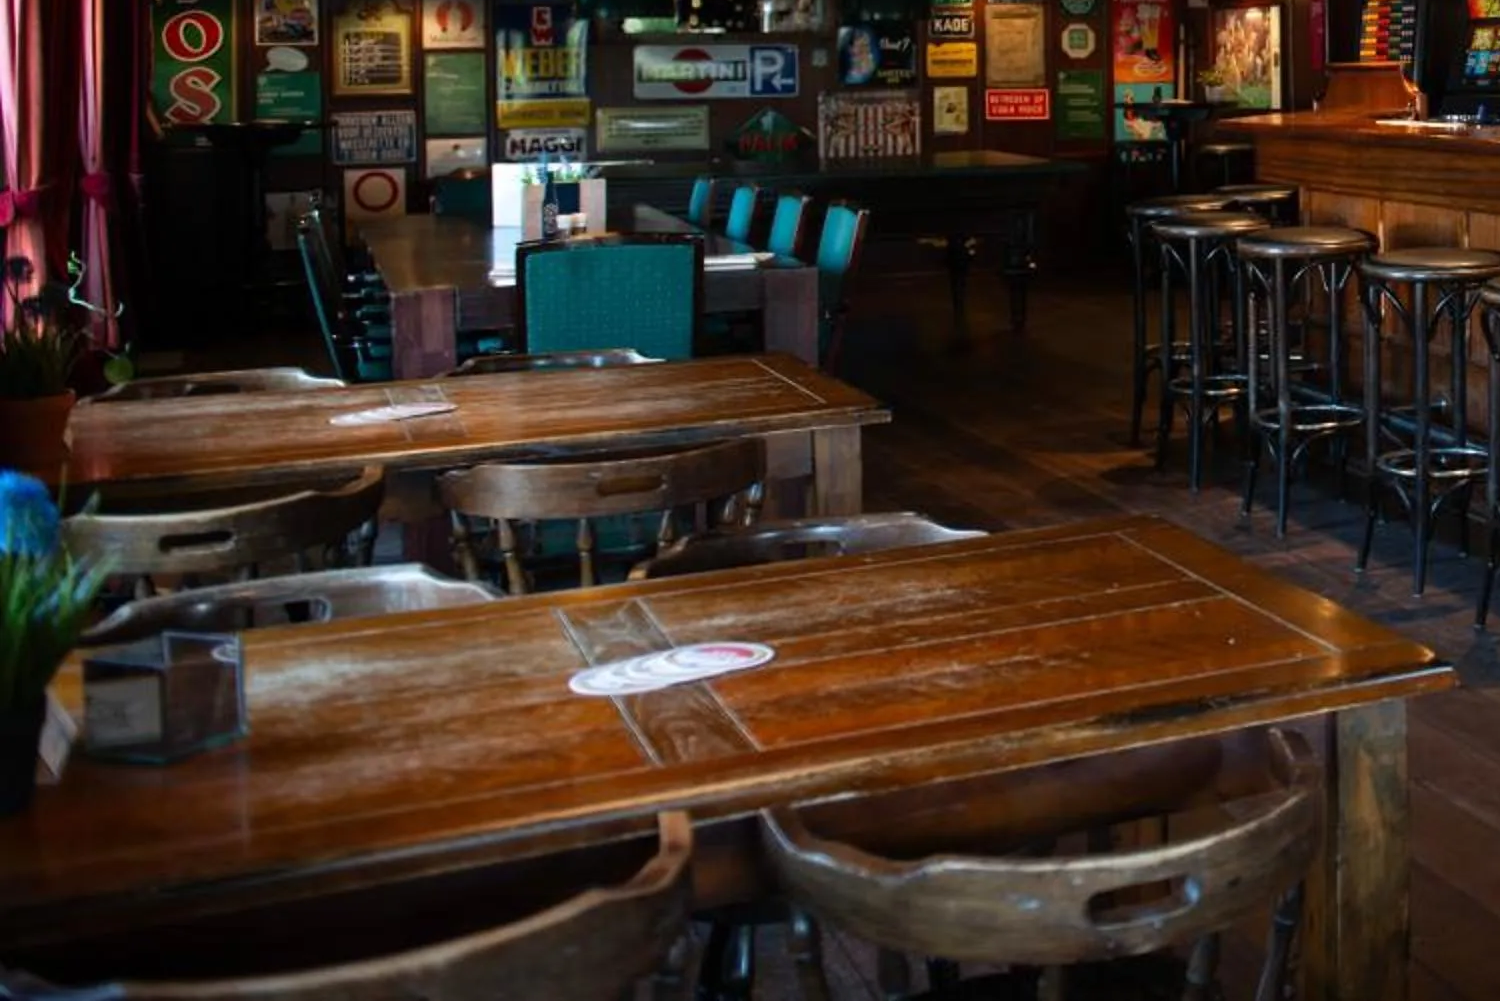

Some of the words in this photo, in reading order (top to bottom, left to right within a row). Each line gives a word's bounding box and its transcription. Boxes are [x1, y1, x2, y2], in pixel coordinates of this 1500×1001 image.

[638, 62, 746, 83] MARTINI
[753, 49, 785, 92] P
[509, 136, 582, 155] MAGGI
